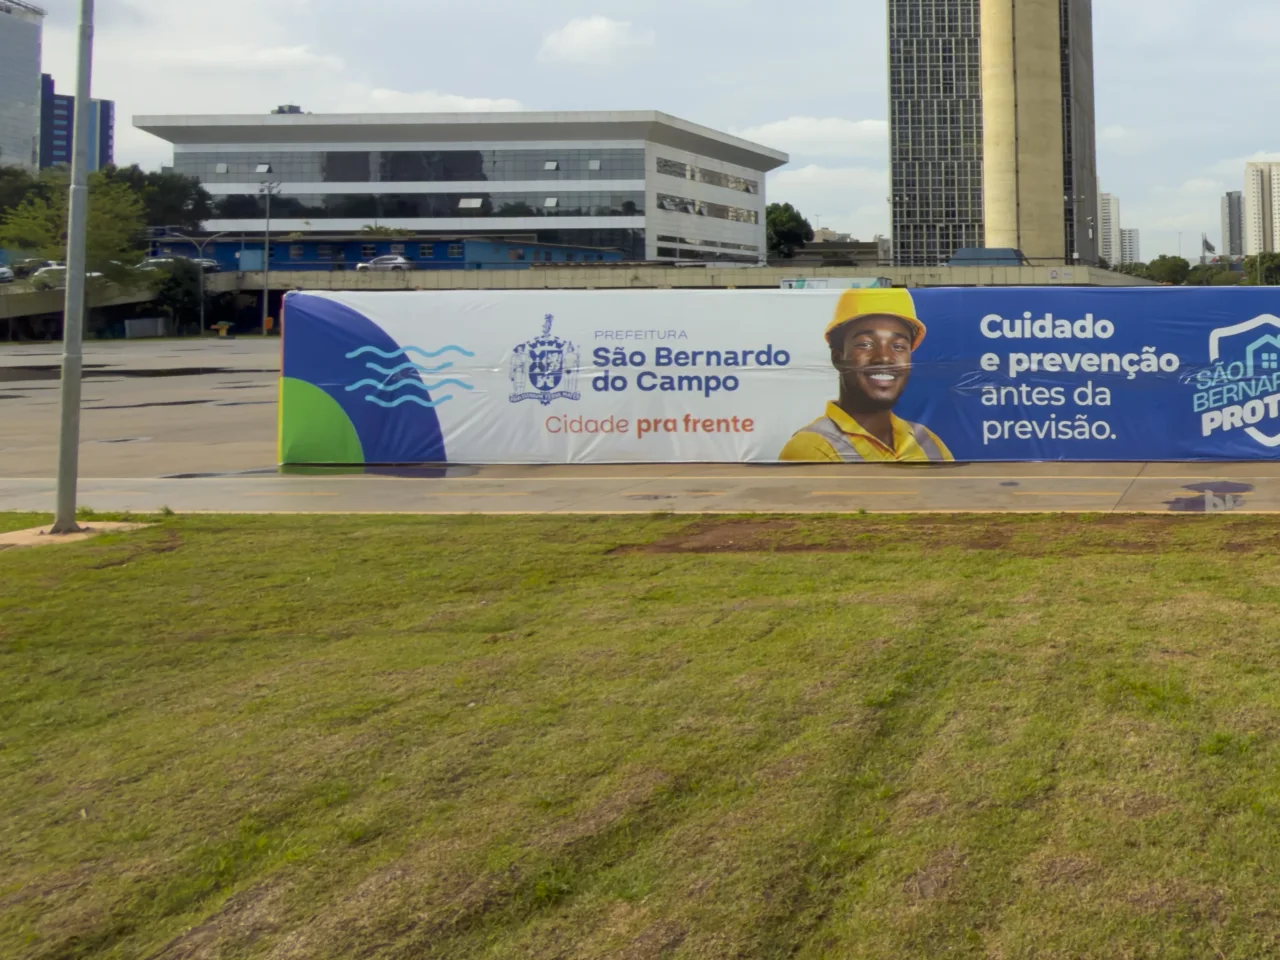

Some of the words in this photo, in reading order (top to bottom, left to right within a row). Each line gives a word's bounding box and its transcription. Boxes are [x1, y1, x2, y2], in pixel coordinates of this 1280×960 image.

[594, 330, 688, 340] PREFEITURA
[980, 312, 1114, 339] Cuidado
[592, 345, 646, 368] São
[655, 344, 791, 368] Bernardo
[980, 352, 1001, 372] e
[1009, 346, 1180, 379] prevenção
[592, 370, 628, 392] do
[636, 371, 740, 398] Campo
[1196, 358, 1245, 389] SÃO
[981, 382, 1065, 406] antes
[1073, 380, 1111, 406] da
[545, 414, 629, 434] Cidade
[636, 418, 677, 439] pra
[683, 414, 755, 434] frente
[982, 415, 1117, 445] previsão.
